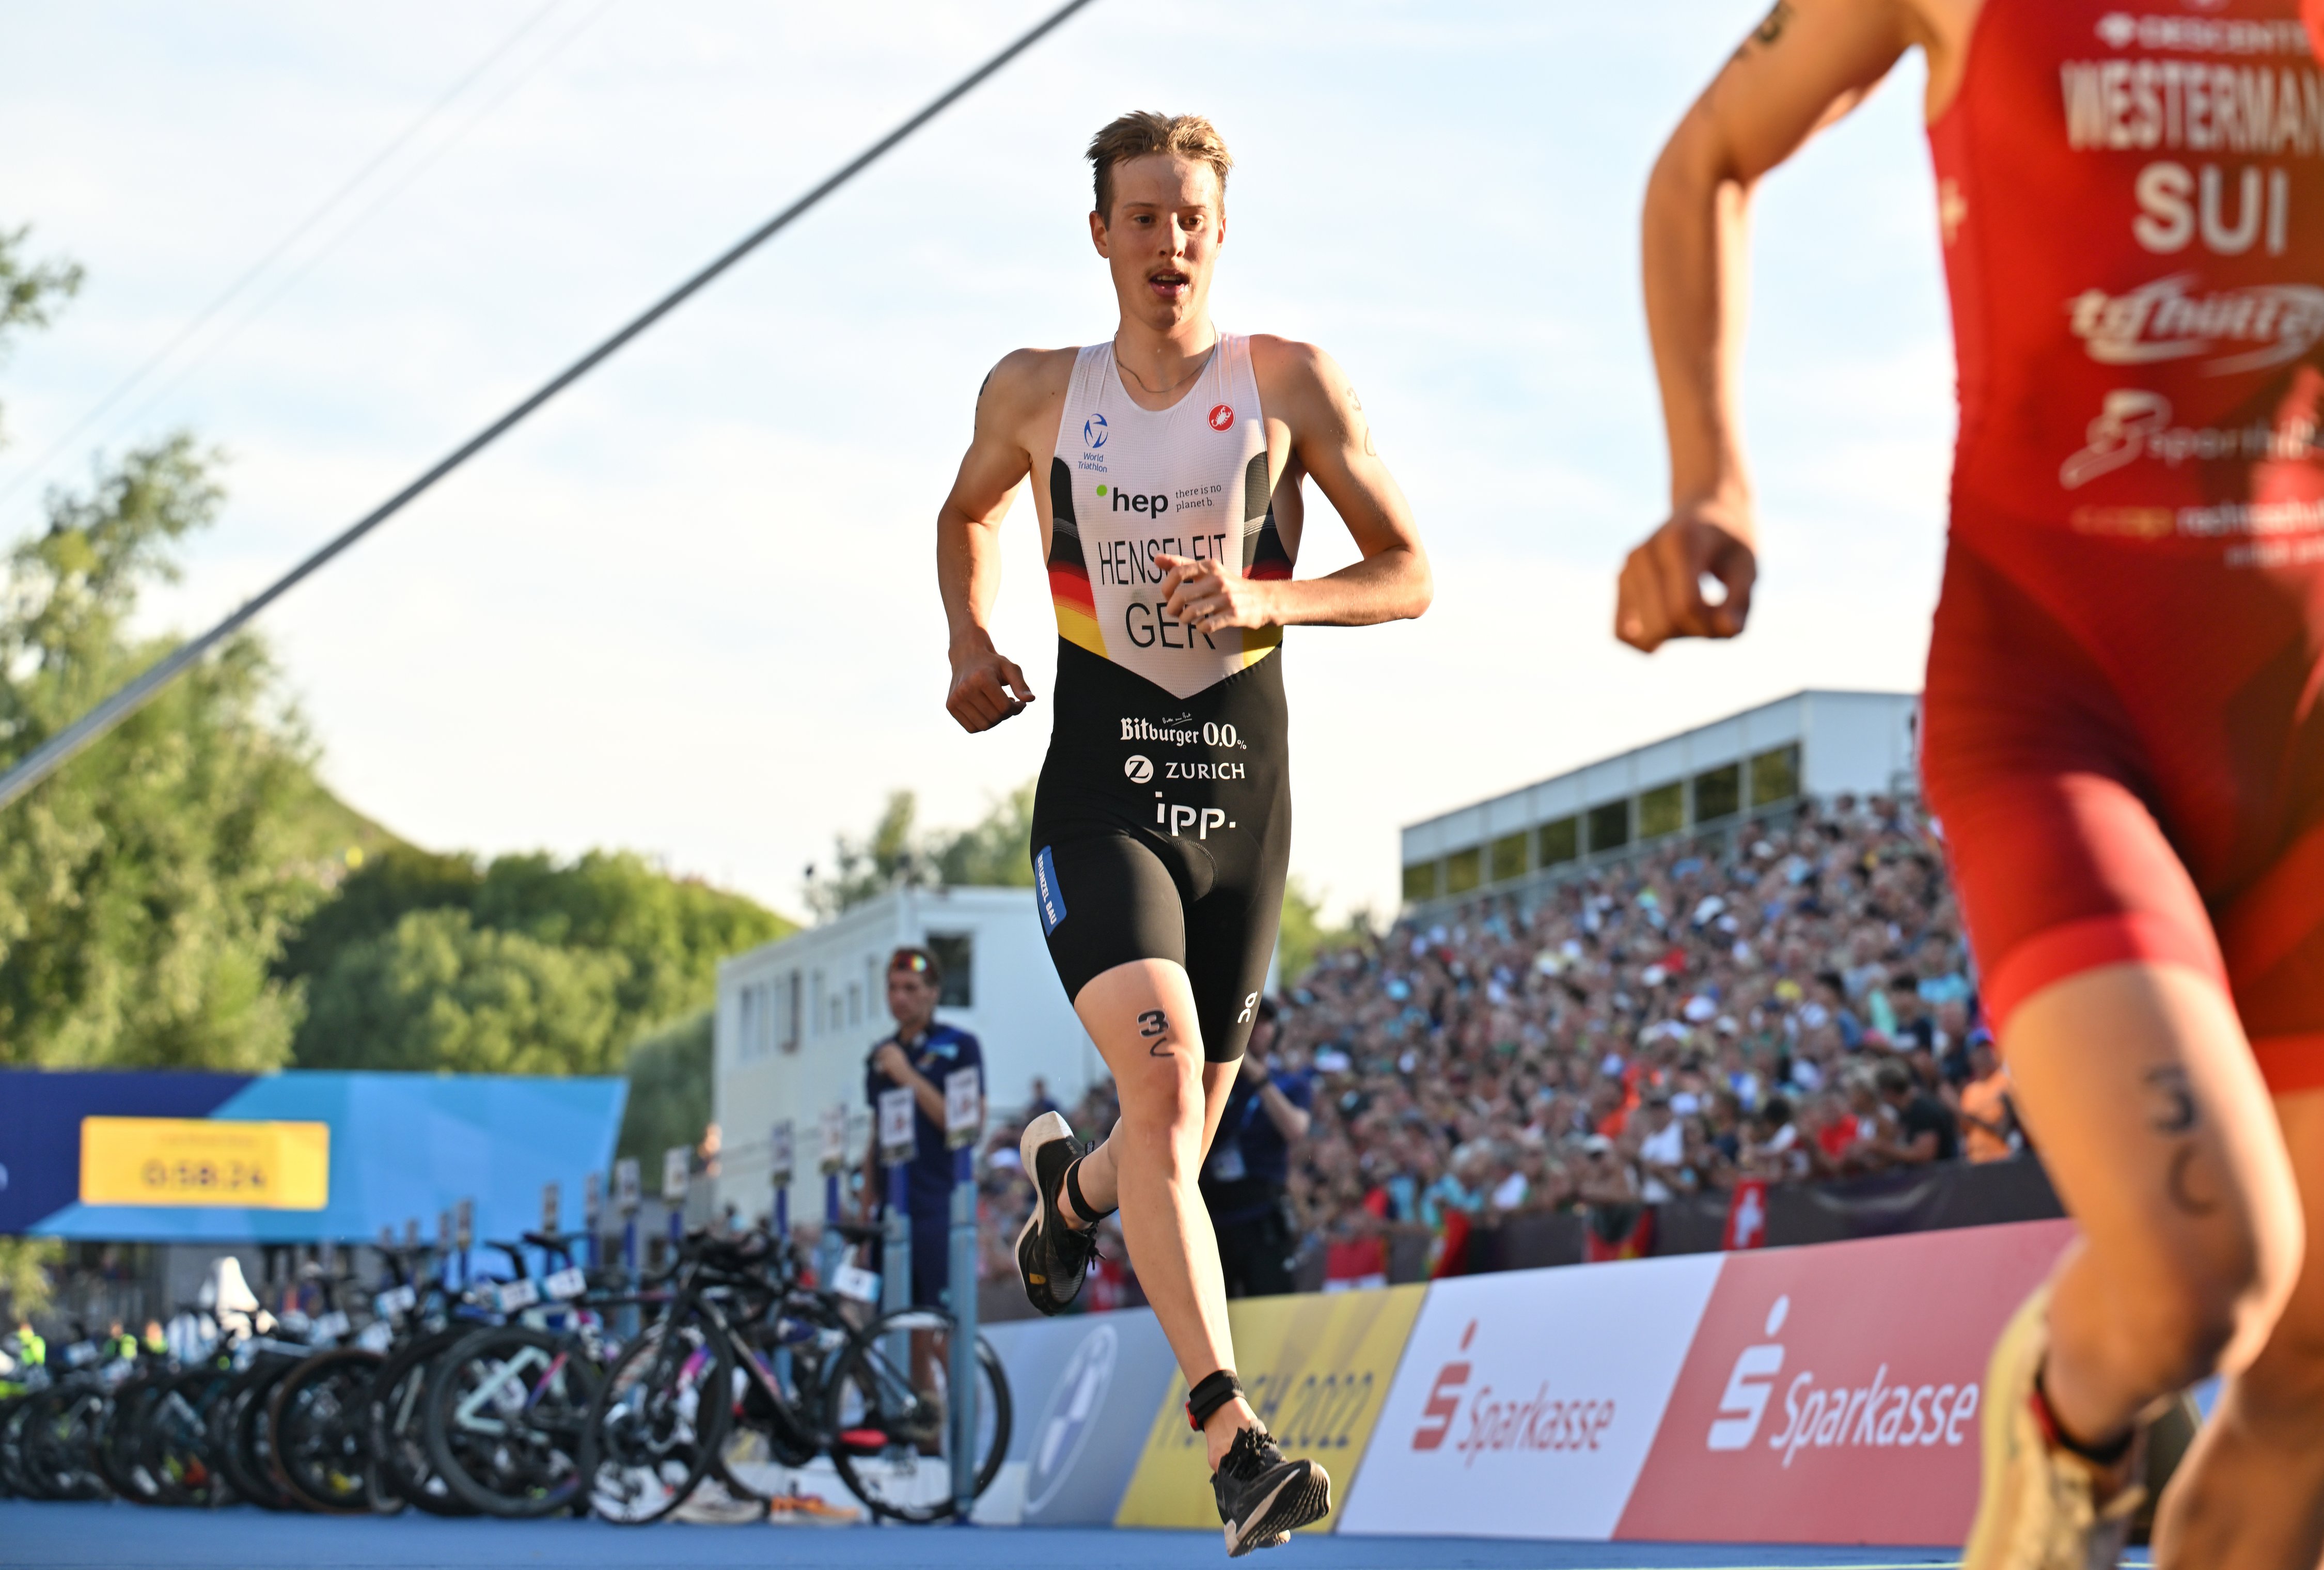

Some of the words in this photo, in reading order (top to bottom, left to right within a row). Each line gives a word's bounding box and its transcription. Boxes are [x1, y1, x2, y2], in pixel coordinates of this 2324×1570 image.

[2132, 161, 2289, 255] SUI
[1078, 461, 1107, 473] Triathlon
[1084, 452, 1104, 462] World
[1112, 487, 1168, 519] hep
[1175, 489, 1198, 499] there
[1201, 484, 1208, 494] is
[1210, 484, 1221, 493] no
[1176, 498, 1205, 512] planet
[1125, 602, 1216, 650] GER
[1120, 717, 1199, 747] Bitburger
[1165, 762, 1246, 780] ZURICH
[1038, 853, 1049, 904] BRUNZEL
[1046, 900, 1057, 925] BAU
[1137, 1008, 1170, 1039] 3
[1457, 1379, 1615, 1469] Sparkasse
[1769, 1362, 1980, 1470] Sparkasse
